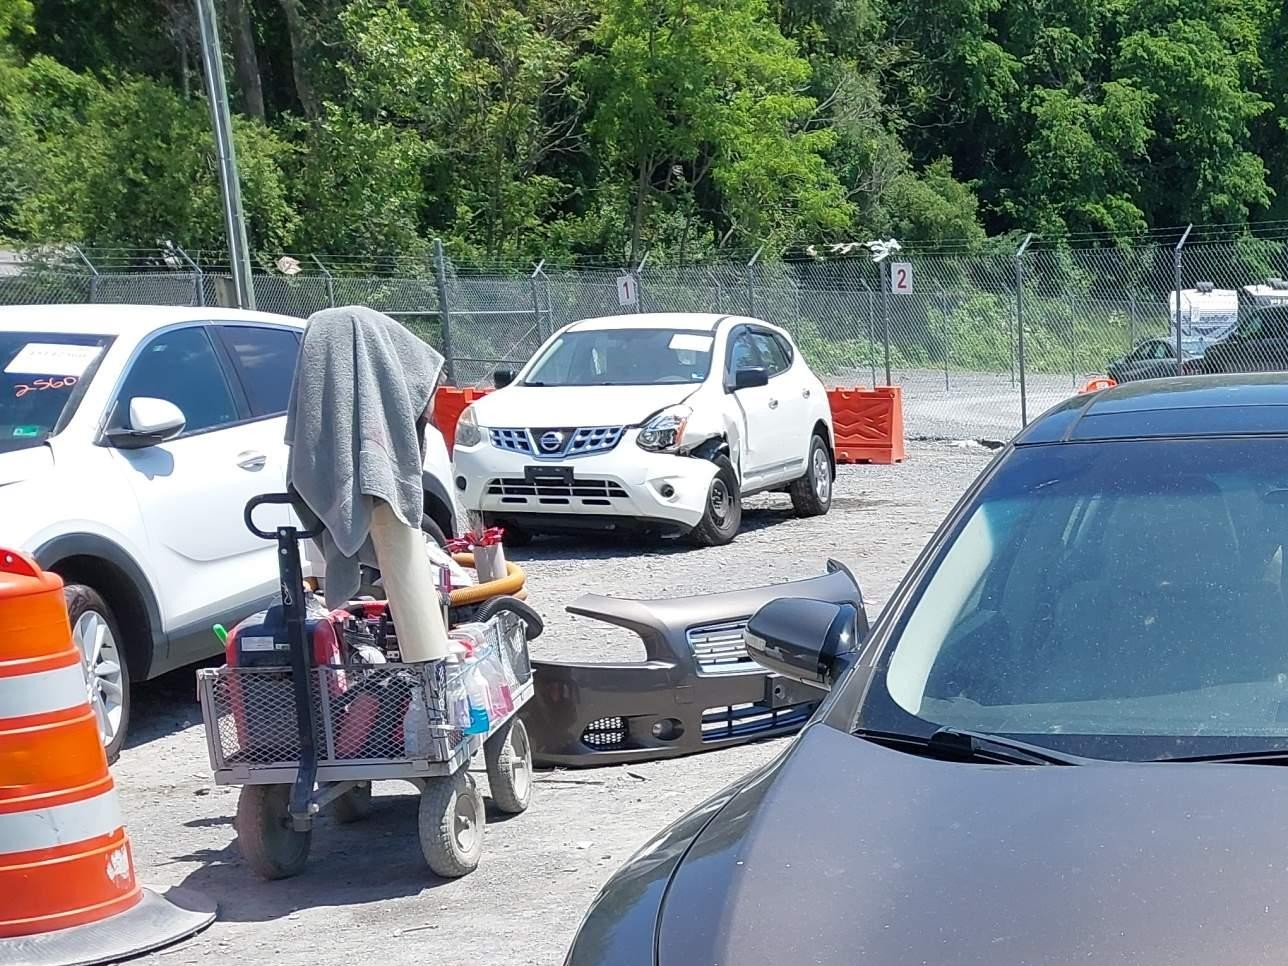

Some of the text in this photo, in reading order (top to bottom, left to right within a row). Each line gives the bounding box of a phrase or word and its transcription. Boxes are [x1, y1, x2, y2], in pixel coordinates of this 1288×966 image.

[897, 268, 907, 289] 2
[622, 281, 630, 299] 1
[14, 376, 77, 398] 2560
